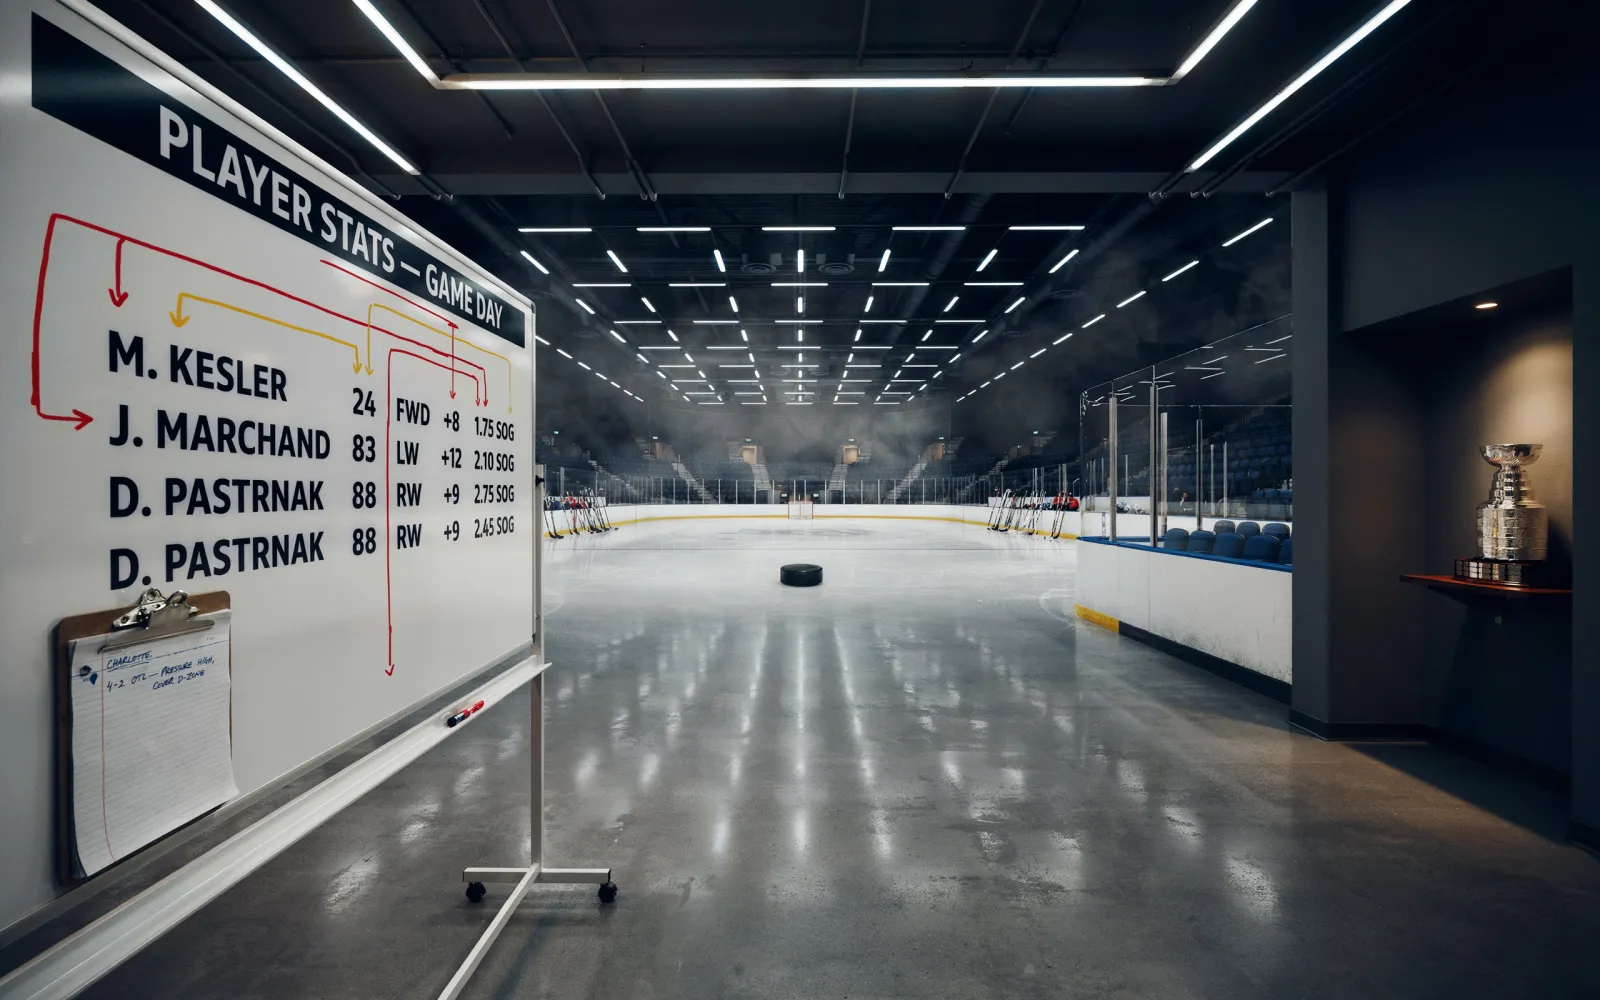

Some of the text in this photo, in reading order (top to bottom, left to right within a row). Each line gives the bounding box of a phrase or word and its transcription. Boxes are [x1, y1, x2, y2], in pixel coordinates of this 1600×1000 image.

[160, 105, 312, 233] PLAYER
[321, 202, 395, 273] STATS
[426, 264, 473, 316] GAME
[476, 287, 504, 329] DAY
[109, 330, 514, 441] M. KESLER 24 FWD +8 1.75 SOG
[110, 405, 514, 471] J. MARCHAND 83 LW +12 2.10 SOG
[110, 477, 514, 518] D. PASTRNAK 88 RW +9 2.75 SOG
[110, 516, 513, 590] D. PASTRNAK 88 RW +9 2.45 SOG
[107, 680, 125, 692] 4-2
[161, 661, 192, 677] PRESSURE
[153, 670, 205, 690] COVER D-ZONE
